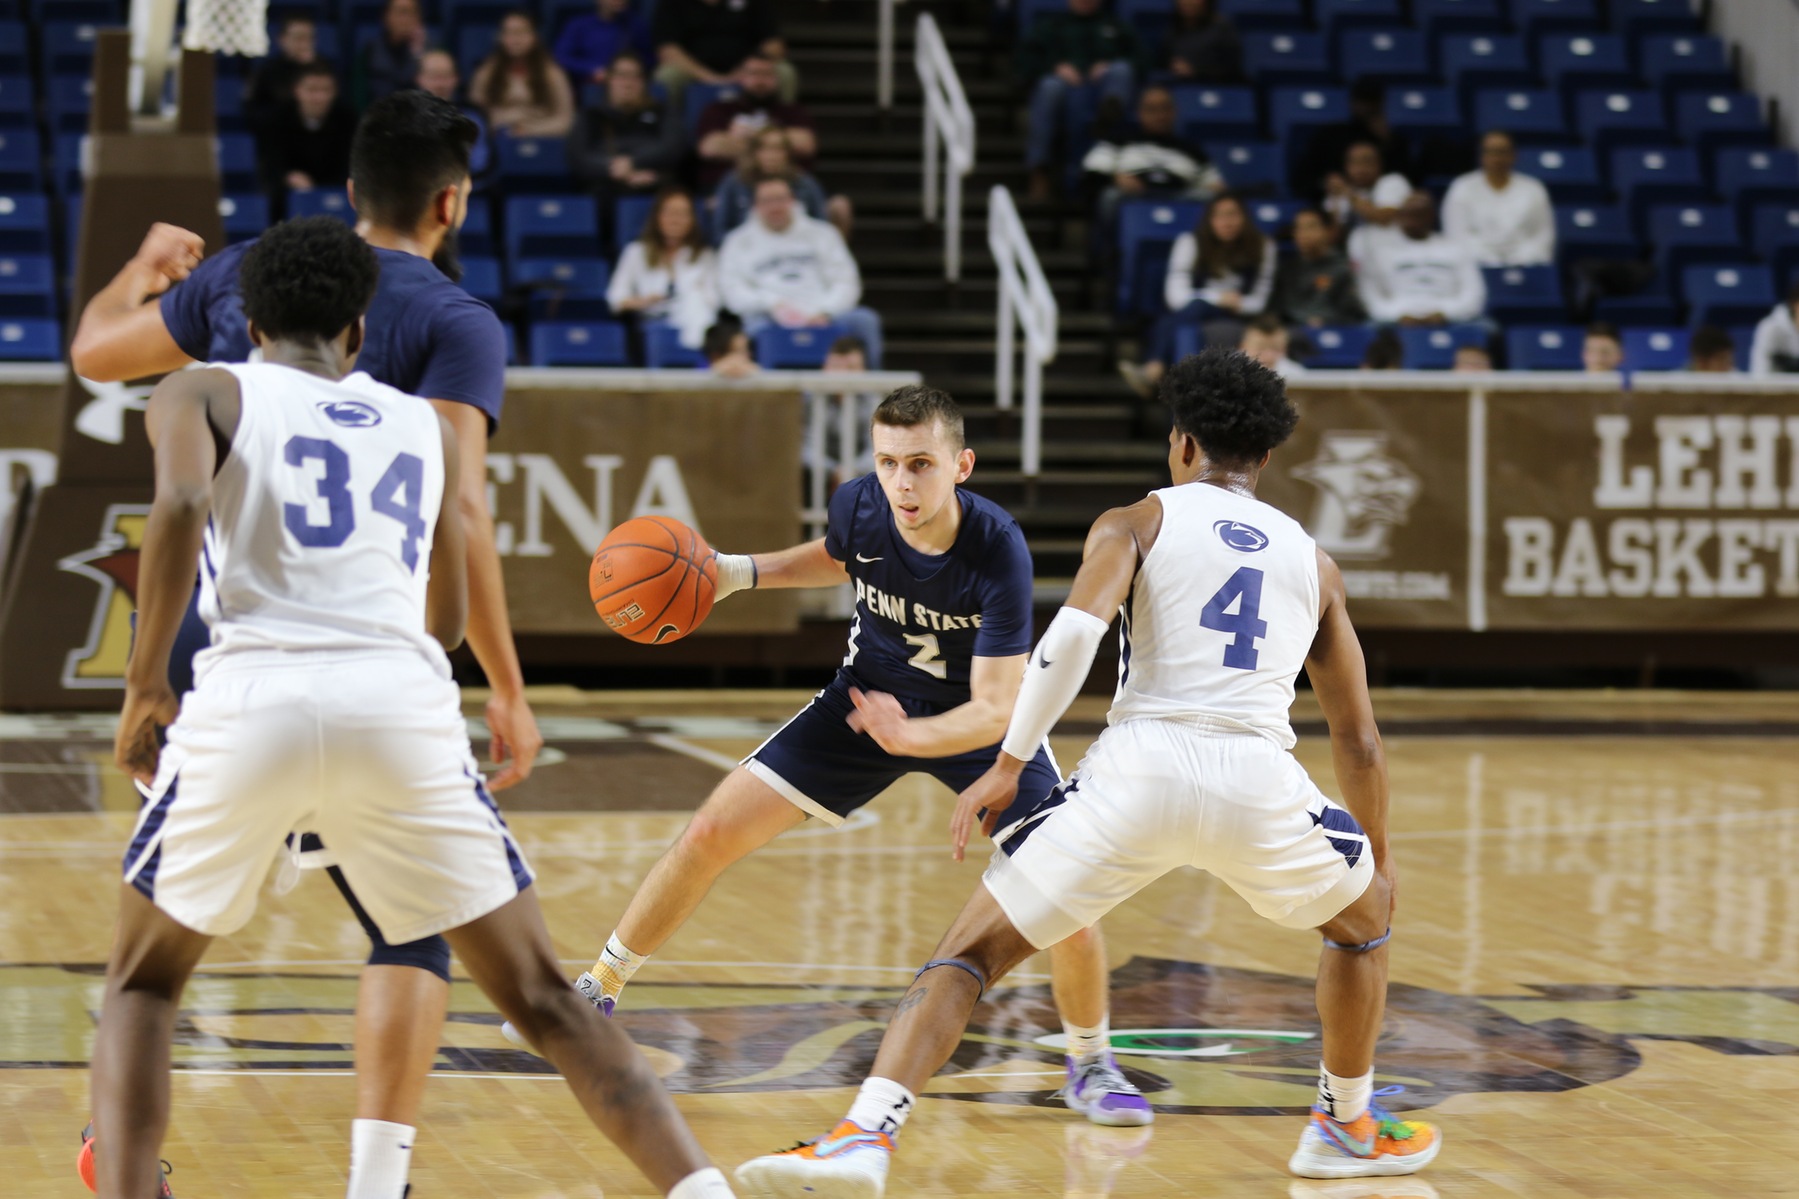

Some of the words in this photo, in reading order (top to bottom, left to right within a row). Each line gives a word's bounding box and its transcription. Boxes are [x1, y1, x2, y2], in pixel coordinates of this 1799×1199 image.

[284, 435, 426, 576] 34
[1503, 517, 1799, 597] BASKET
[856, 577, 906, 626] PENN
[1200, 566, 1267, 671] 4
[902, 633, 947, 679] 2
